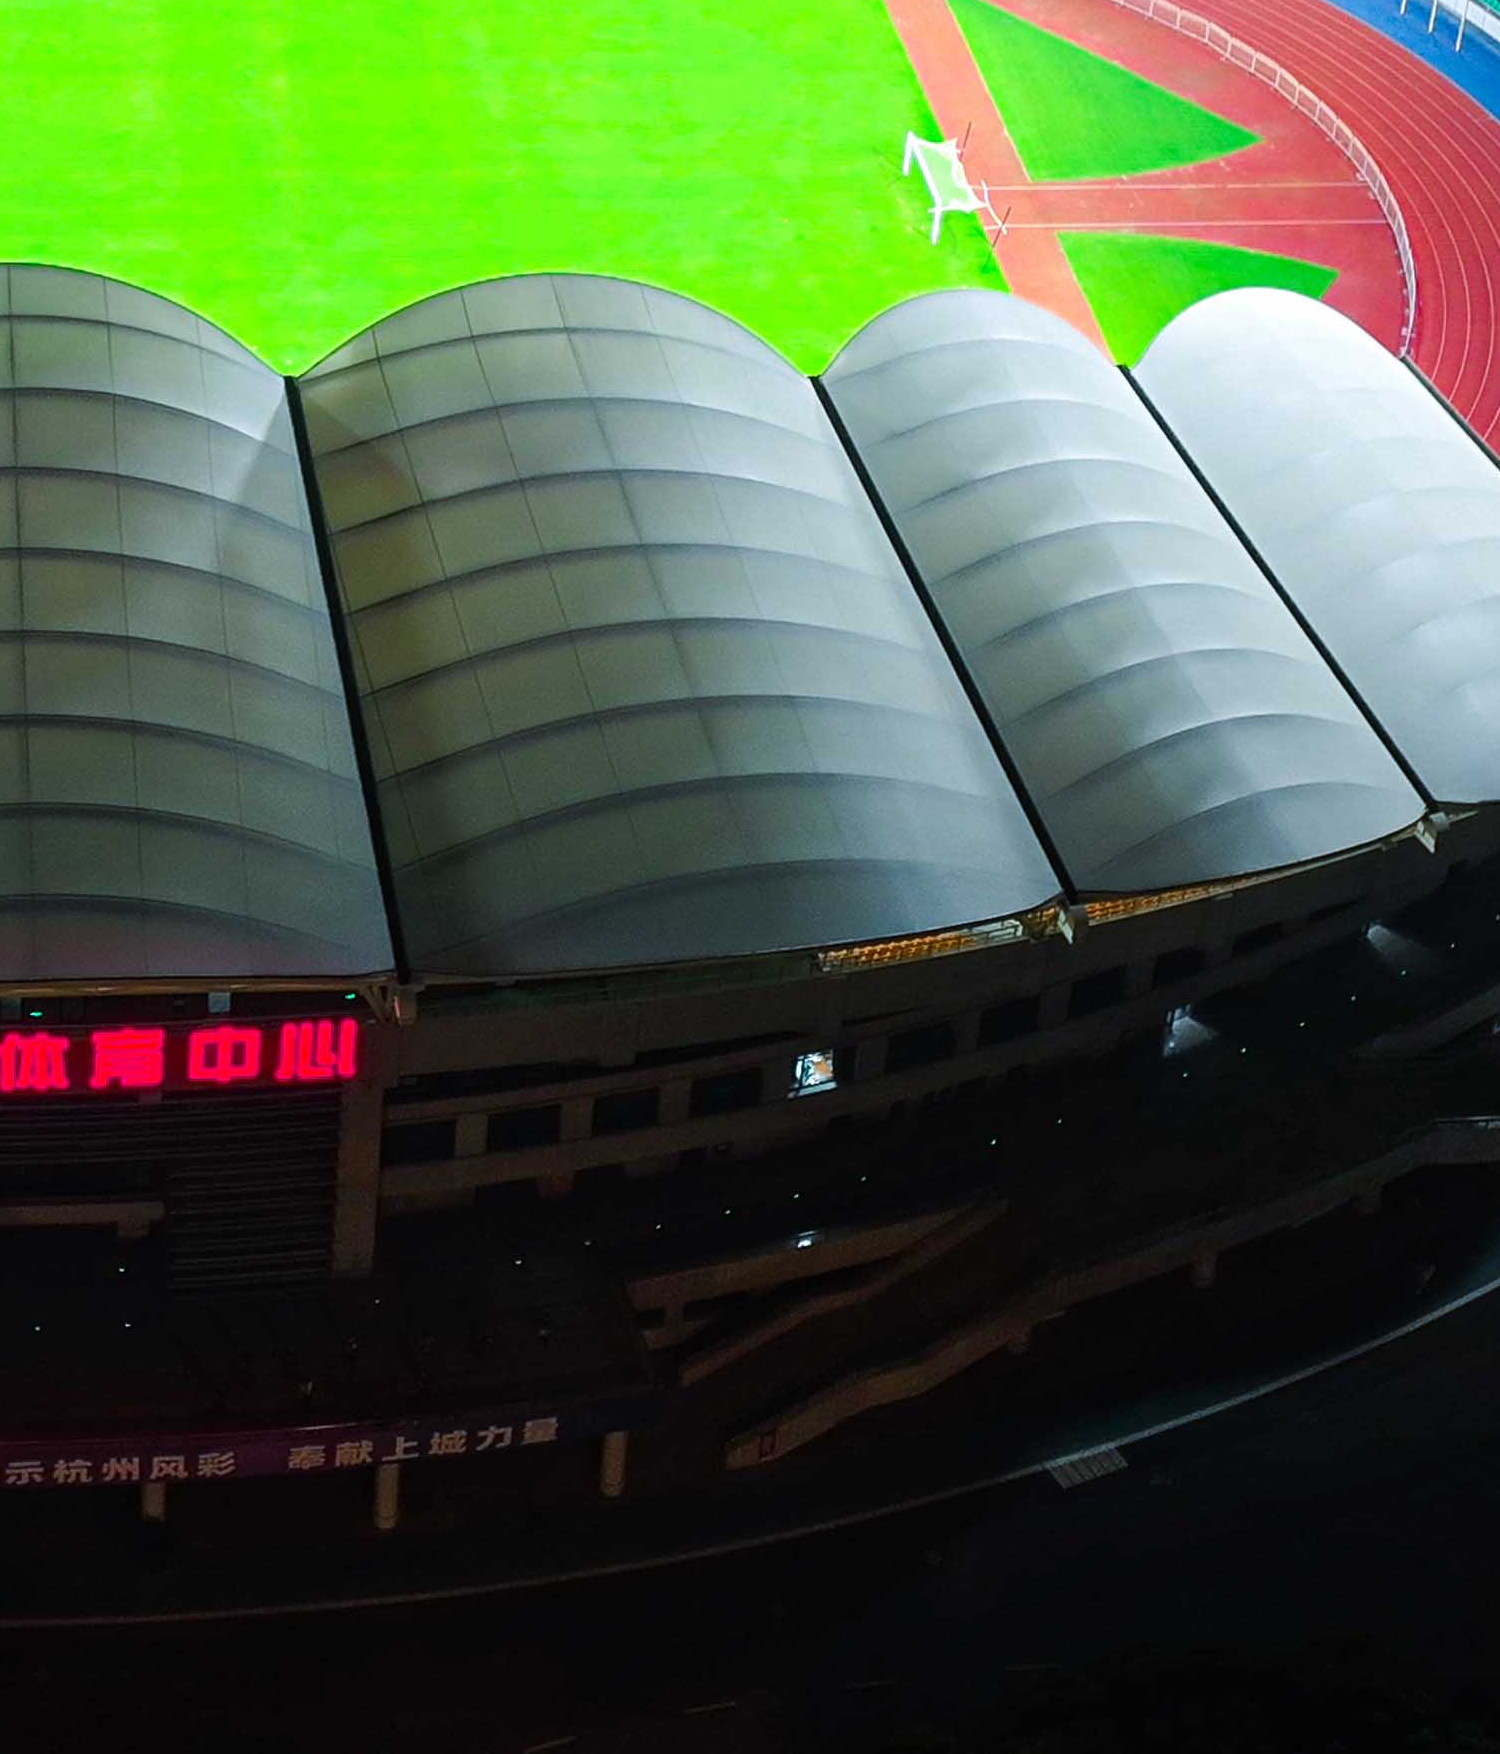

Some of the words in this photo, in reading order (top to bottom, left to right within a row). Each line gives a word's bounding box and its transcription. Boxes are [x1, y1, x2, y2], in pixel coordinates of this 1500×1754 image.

[288, 1417, 558, 1469] 奉献上城力量
